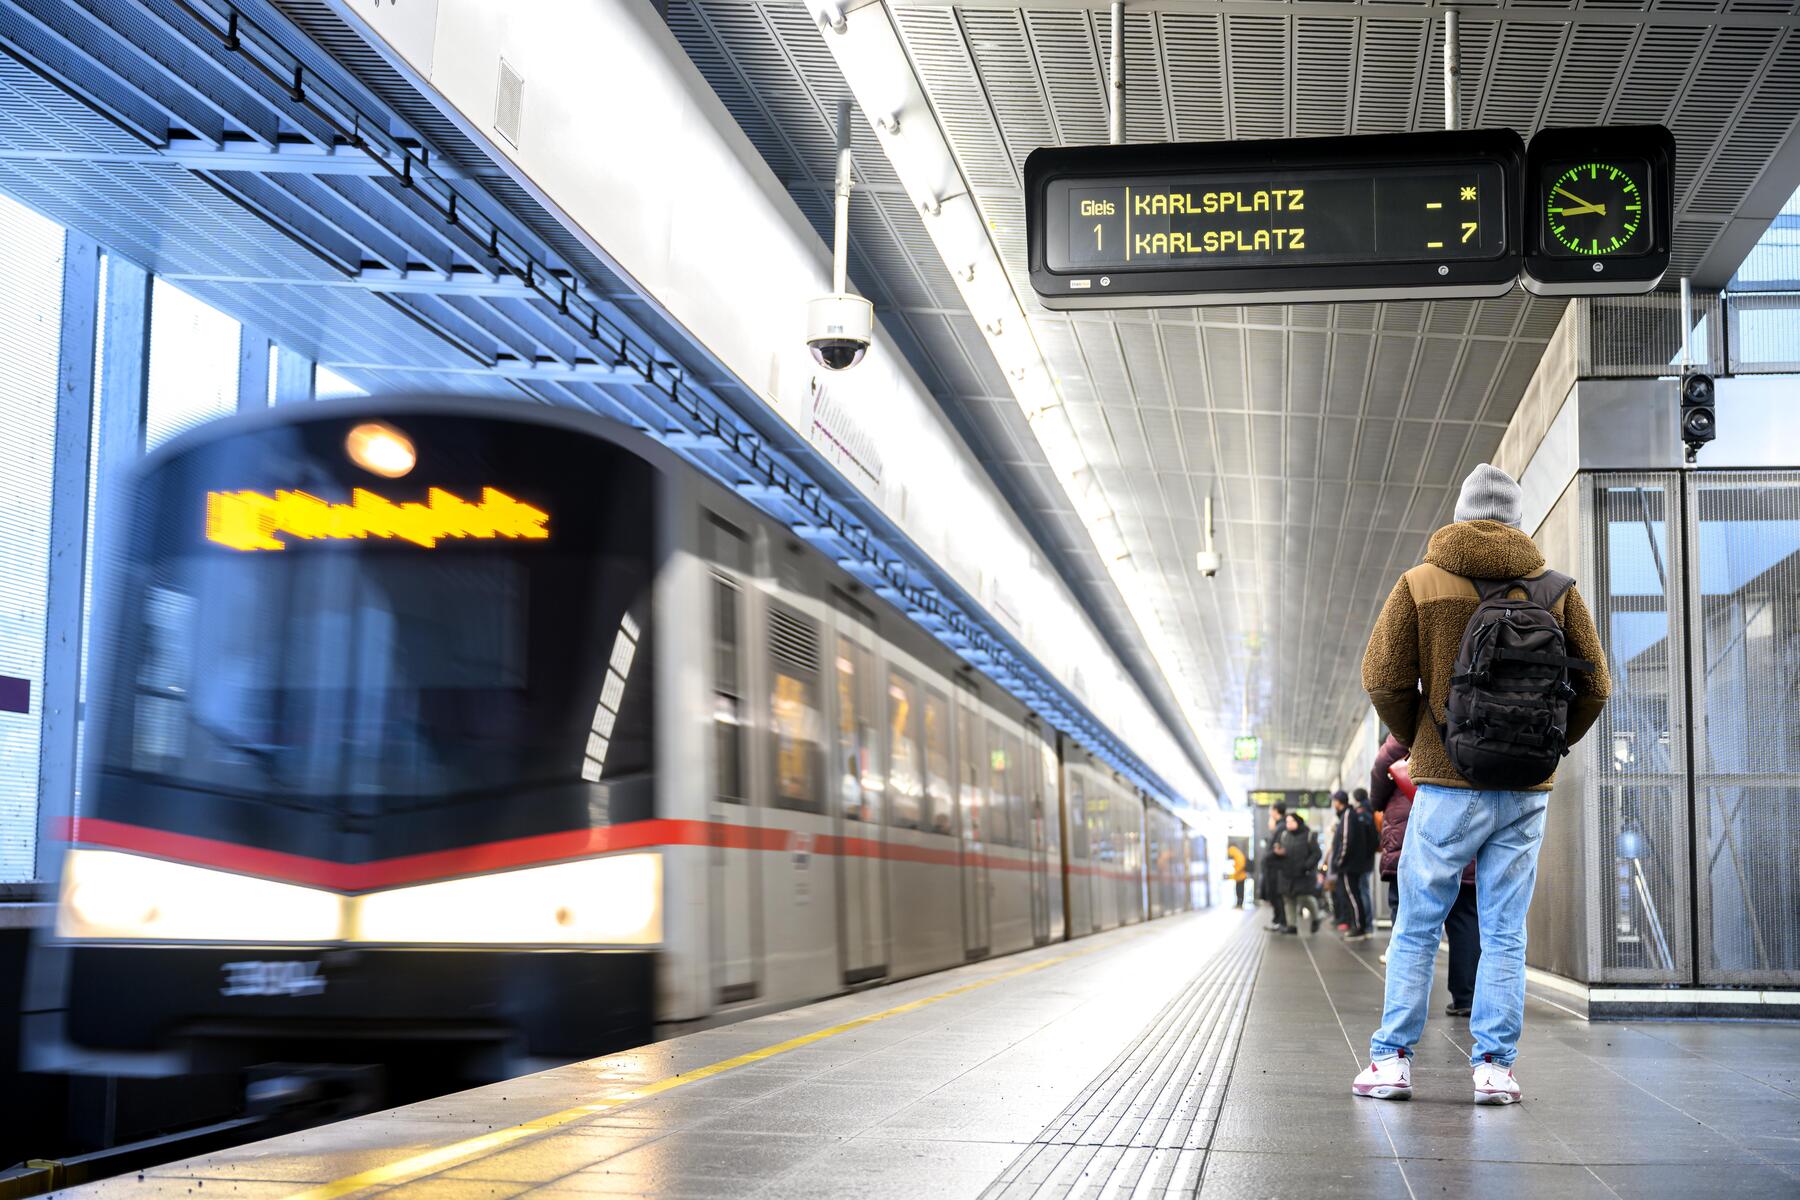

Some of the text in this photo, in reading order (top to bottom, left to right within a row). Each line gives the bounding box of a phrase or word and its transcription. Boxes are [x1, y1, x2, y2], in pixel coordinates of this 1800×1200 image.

[1081, 200, 1115, 216] Gleis
[1135, 190, 1304, 215] KARLSPLATZ
[1093, 223, 1102, 251] 1
[1135, 229, 1304, 255] KARLSPLATZ
[1462, 223, 1477, 243] 7
